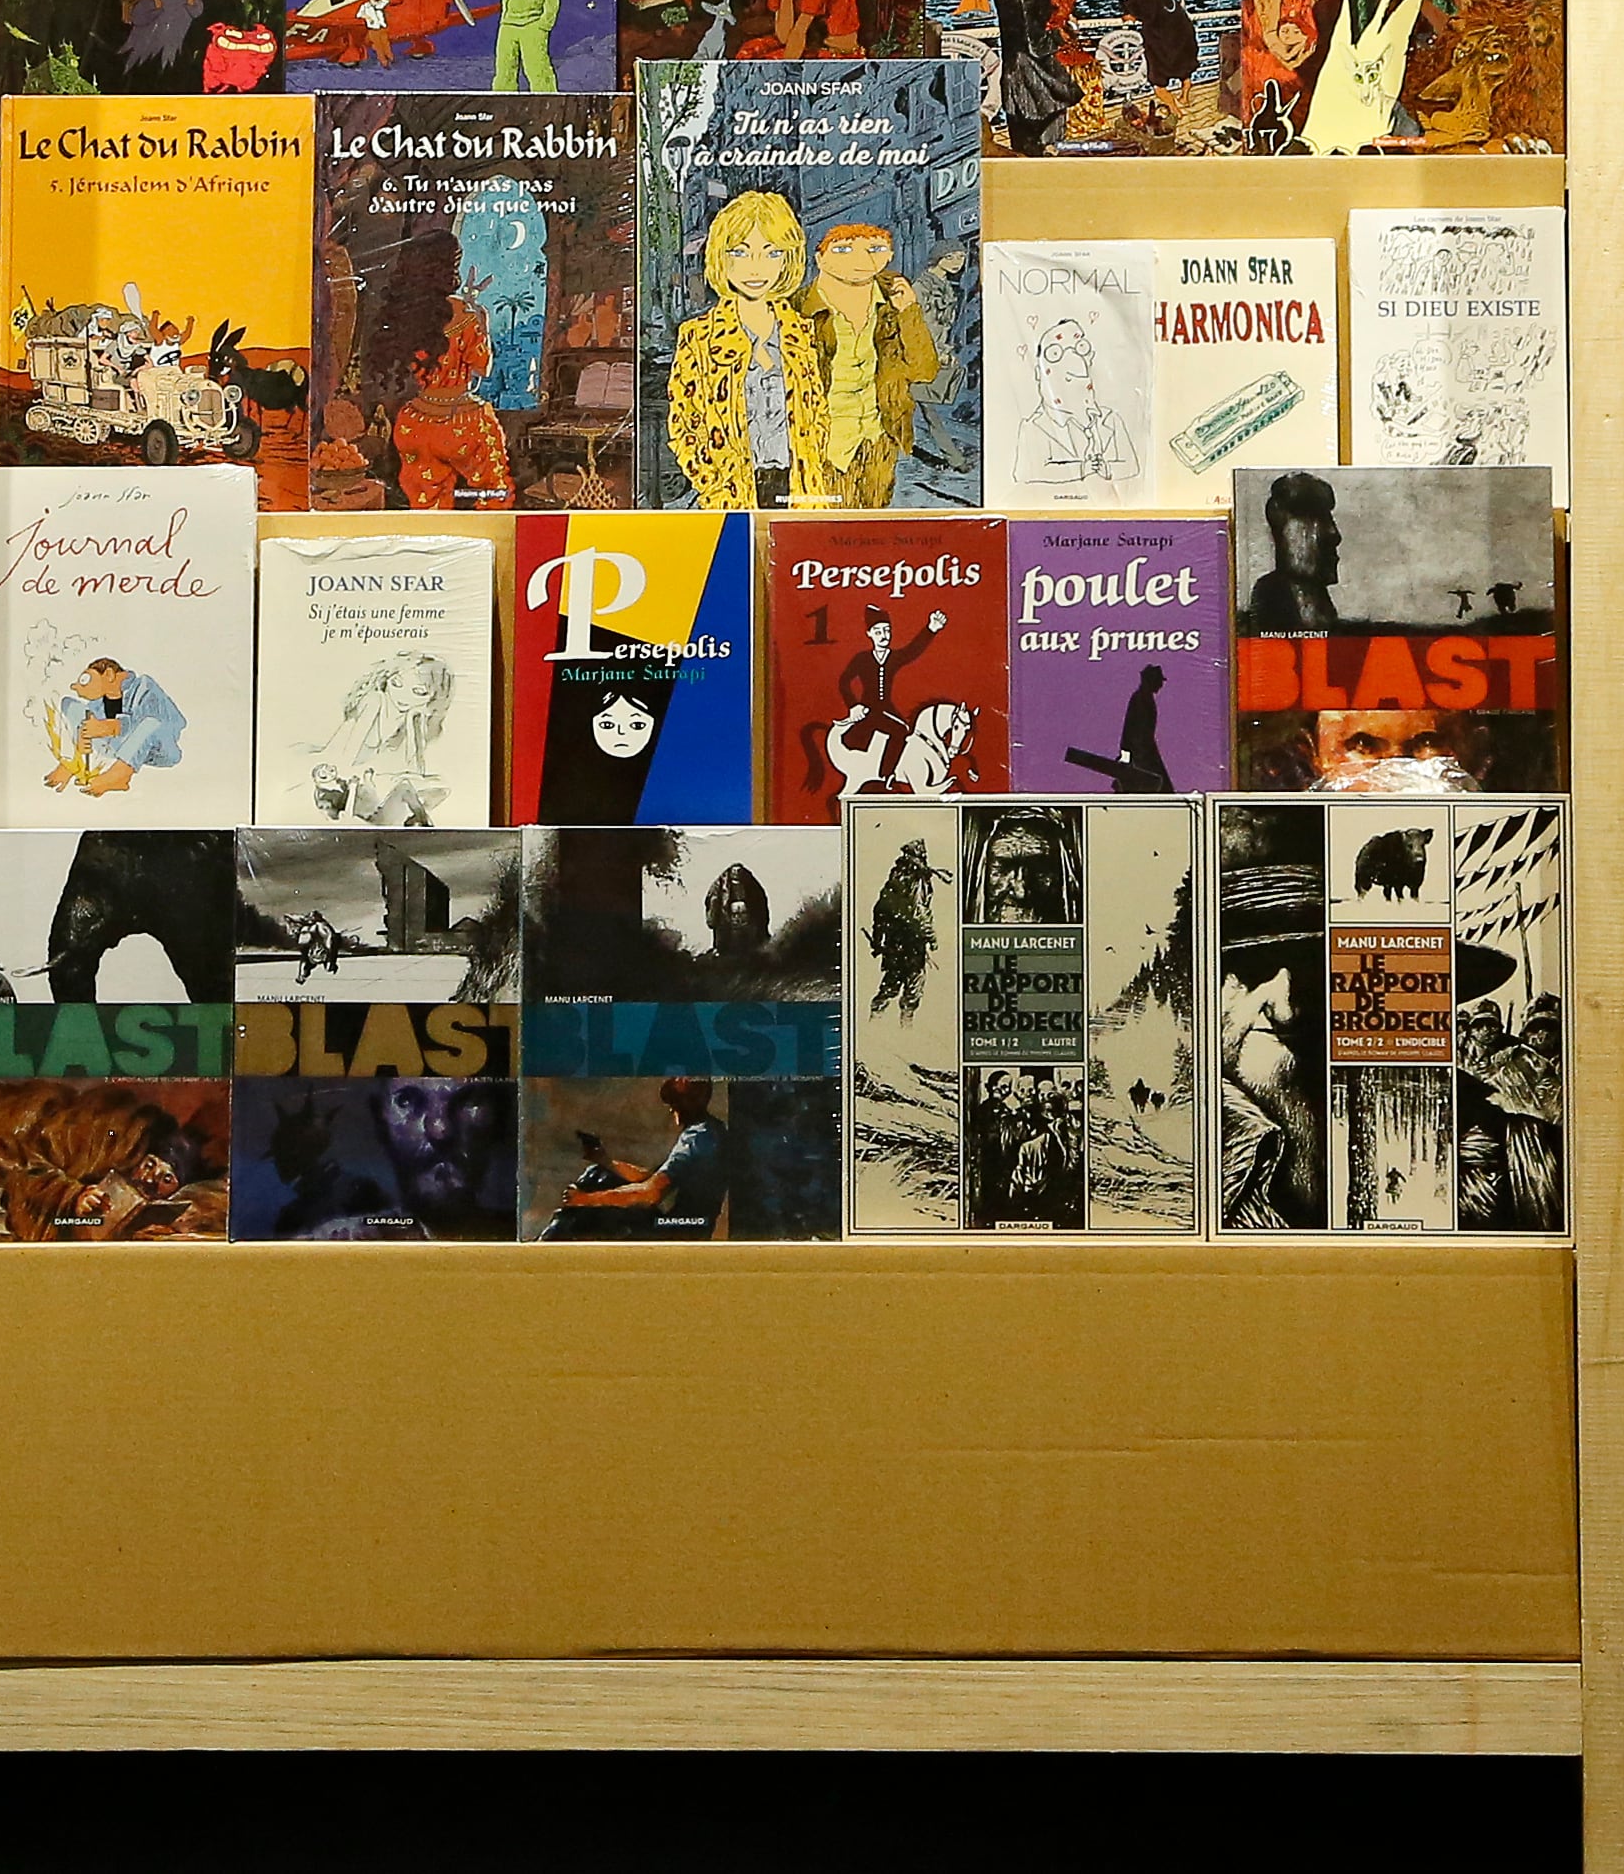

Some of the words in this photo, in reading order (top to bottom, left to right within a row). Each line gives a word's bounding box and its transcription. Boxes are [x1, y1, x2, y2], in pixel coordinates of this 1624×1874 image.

[760, 82, 816, 96] JOANN
[821, 82, 862, 96] SFAR
[59, 127, 132, 159] Chat
[139, 128, 178, 158] du
[187, 126, 301, 158] Rabbin
[720, 140, 834, 166] craindre
[878, 145, 928, 165] moi
[68, 175, 171, 195] Jérusalem
[177, 175, 270, 195] d'Afrique
[493, 199, 531, 217] que
[538, 197, 576, 213] moi
[1180, 258, 1238, 285] JOANN
[1249, 257, 1293, 284] SFAR
[998, 268, 1141, 295] NORMAL
[1378, 301, 1401, 317] SI
[1407, 300, 1459, 317] DIEU
[1467, 301, 1540, 316] EXISTE
[1043, 532, 1109, 552] Marjane
[1117, 532, 1173, 550] Satrapi
[307, 575, 384, 597] JOANN
[390, 576, 444, 592] SFAR
[792, 555, 981, 600] Persepolis
[1018, 556, 1199, 626] poulet
[339, 624, 429, 642] m'épouserais
[1020, 630, 1080, 653] aux
[1089, 628, 1200, 660] prunes
[1237, 636, 1555, 711] BLAST
[971, 937, 1009, 949] MANU
[1013, 937, 1076, 949] LARCENET
[1337, 936, 1376, 948] MANU
[1381, 936, 1443, 948] LARCENET
[55, 1217, 102, 1226] DARGAUD
